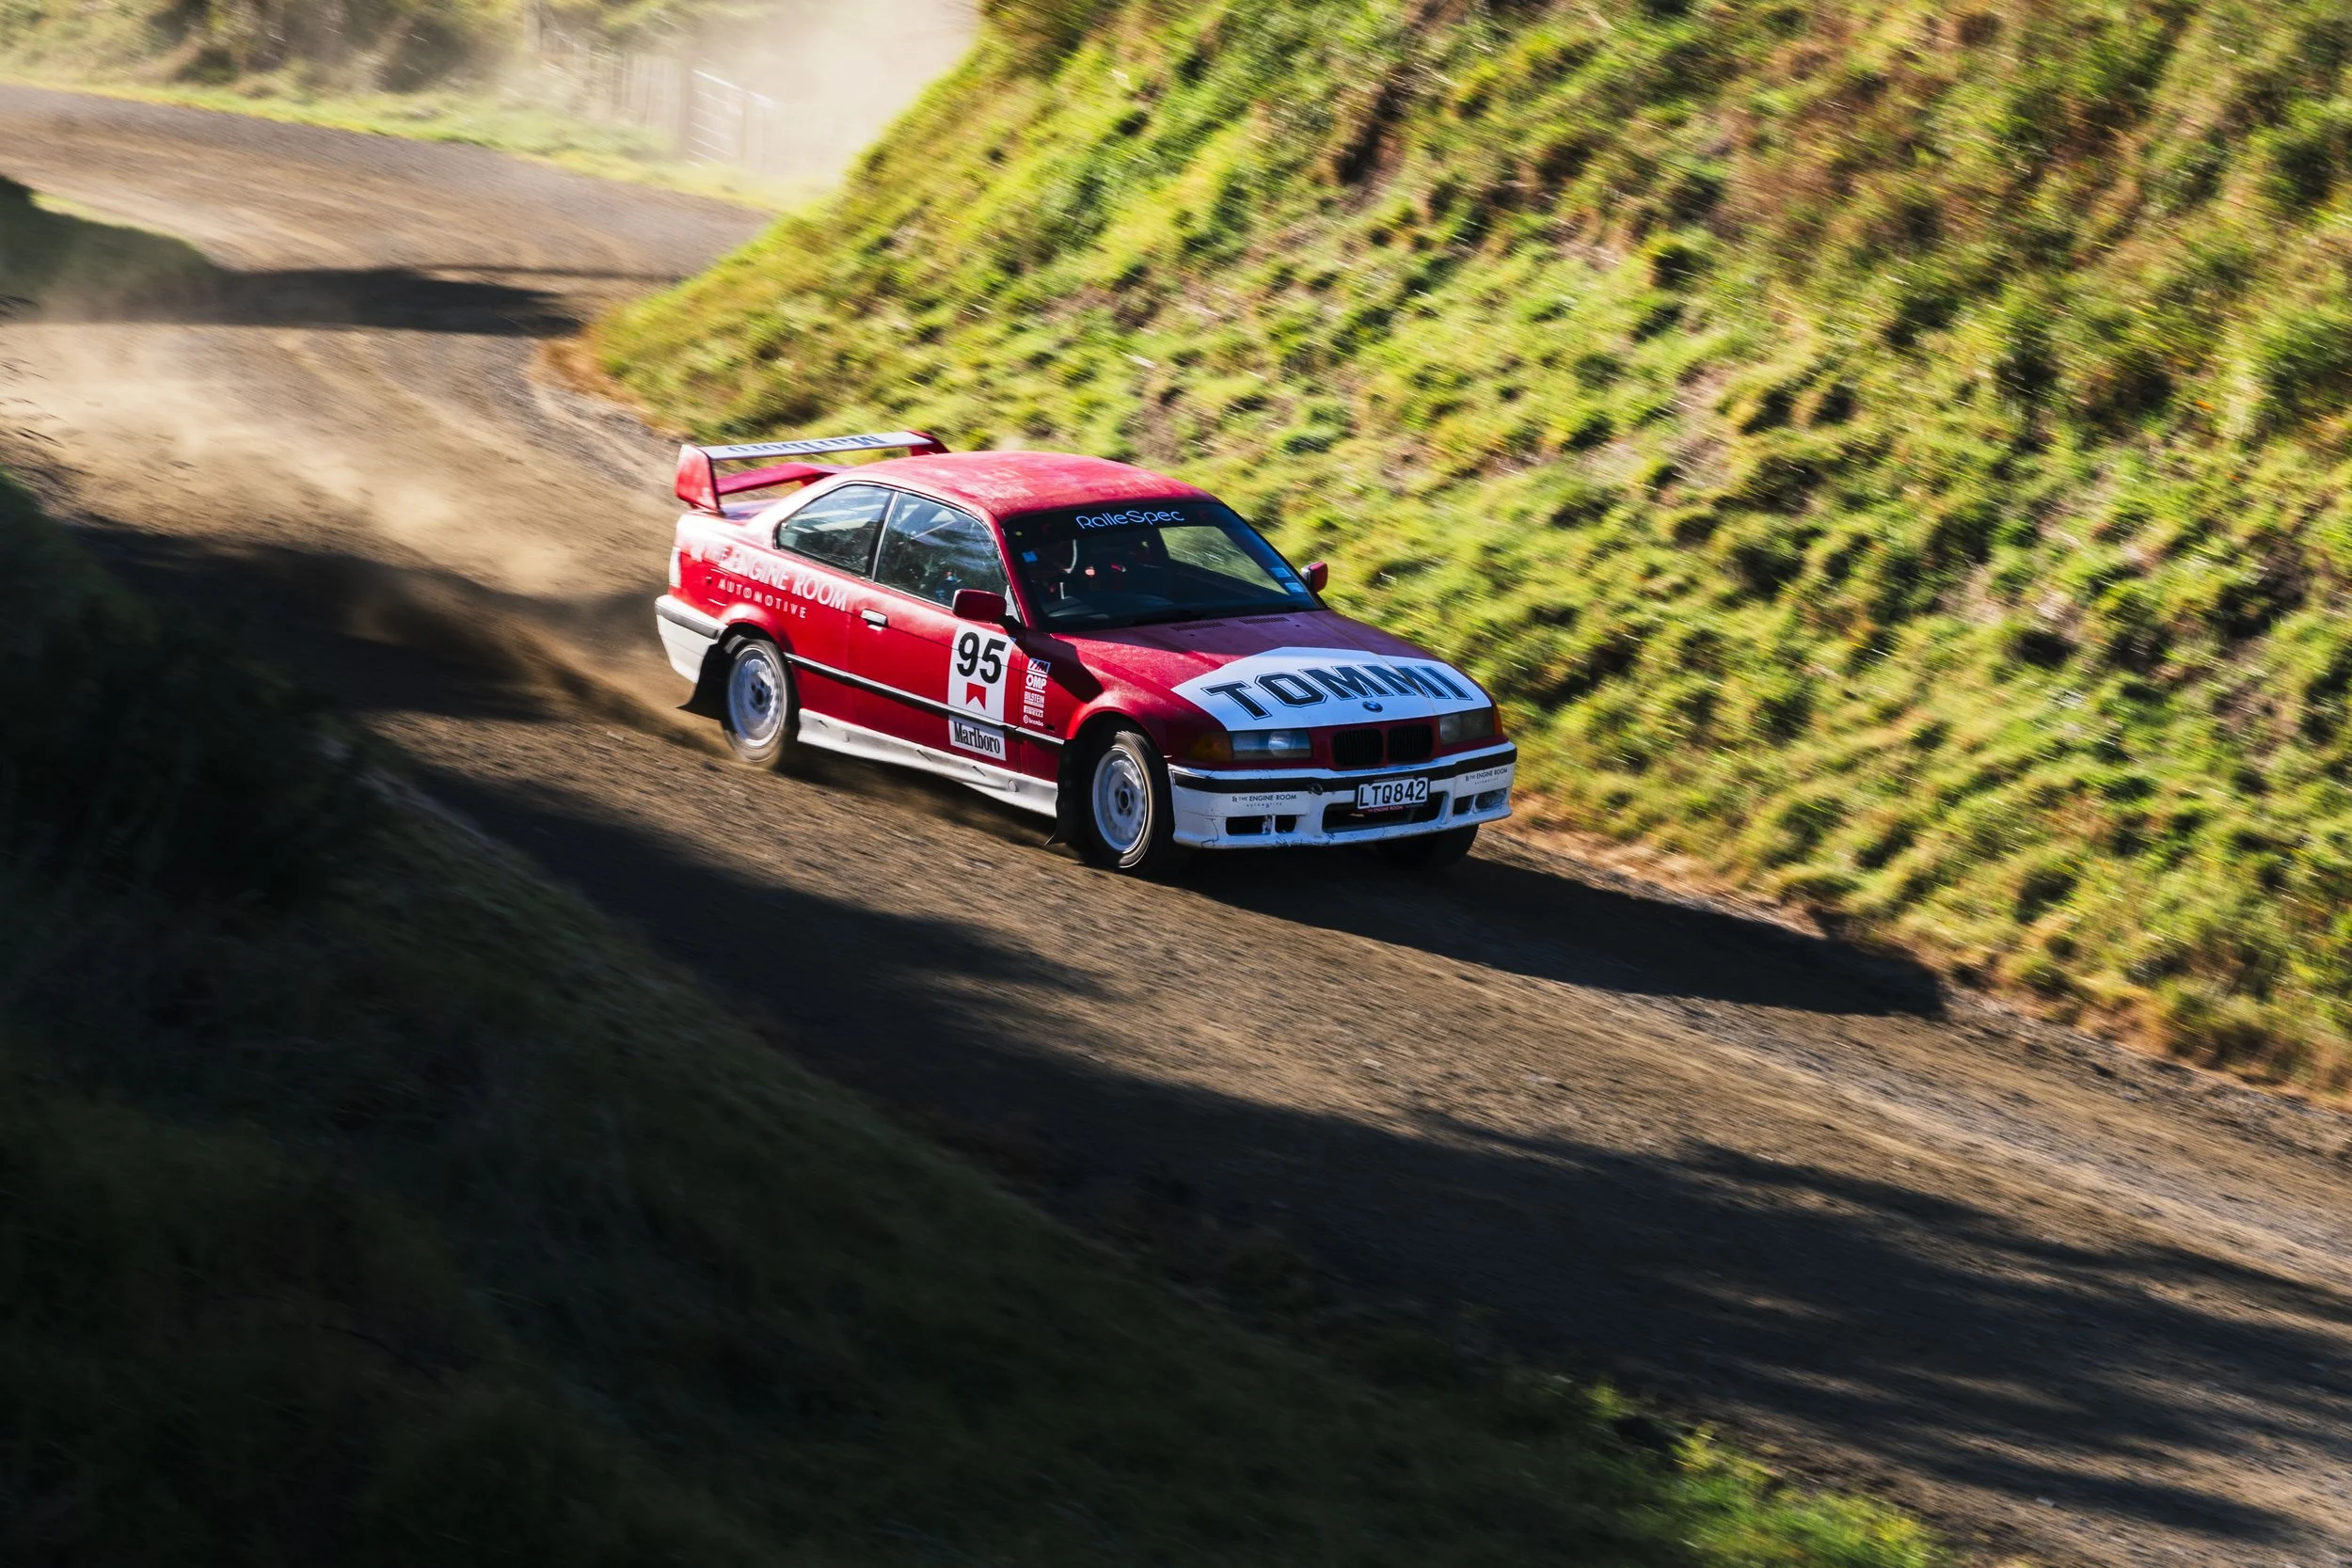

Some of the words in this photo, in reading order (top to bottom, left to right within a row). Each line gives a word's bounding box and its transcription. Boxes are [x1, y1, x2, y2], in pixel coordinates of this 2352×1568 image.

[727, 436, 889, 453] Marlboro
[1075, 510, 1184, 530] RalleSpec
[717, 578, 807, 619] AUTOMOTIVE
[791, 575, 847, 611] ROOM
[956, 631, 1007, 684] 95
[1025, 673, 1047, 689] OMP
[1200, 664, 1474, 721] TOMMI
[954, 721, 1000, 753] Marlboro
[1359, 780, 1426, 807] LTQ842
